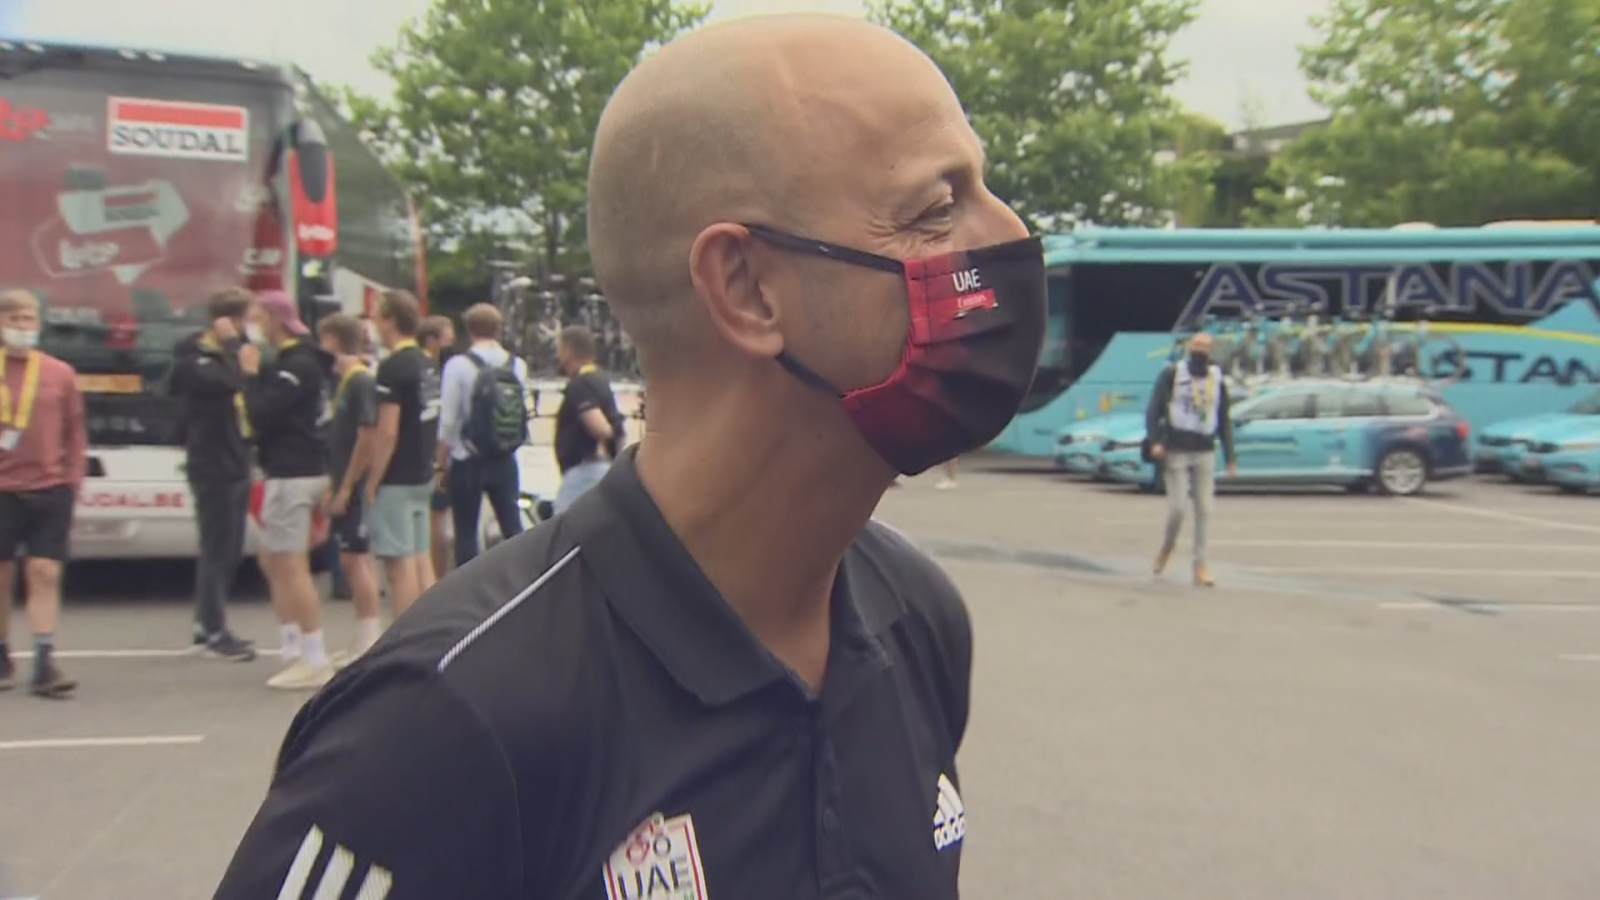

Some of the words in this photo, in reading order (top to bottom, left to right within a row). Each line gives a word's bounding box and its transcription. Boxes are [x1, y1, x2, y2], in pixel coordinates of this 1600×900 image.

[112, 126, 243, 155] SOUDAL
[952, 268, 982, 292] UAE
[1173, 262, 1600, 332] ASTANA
[617, 856, 694, 900] UAE
